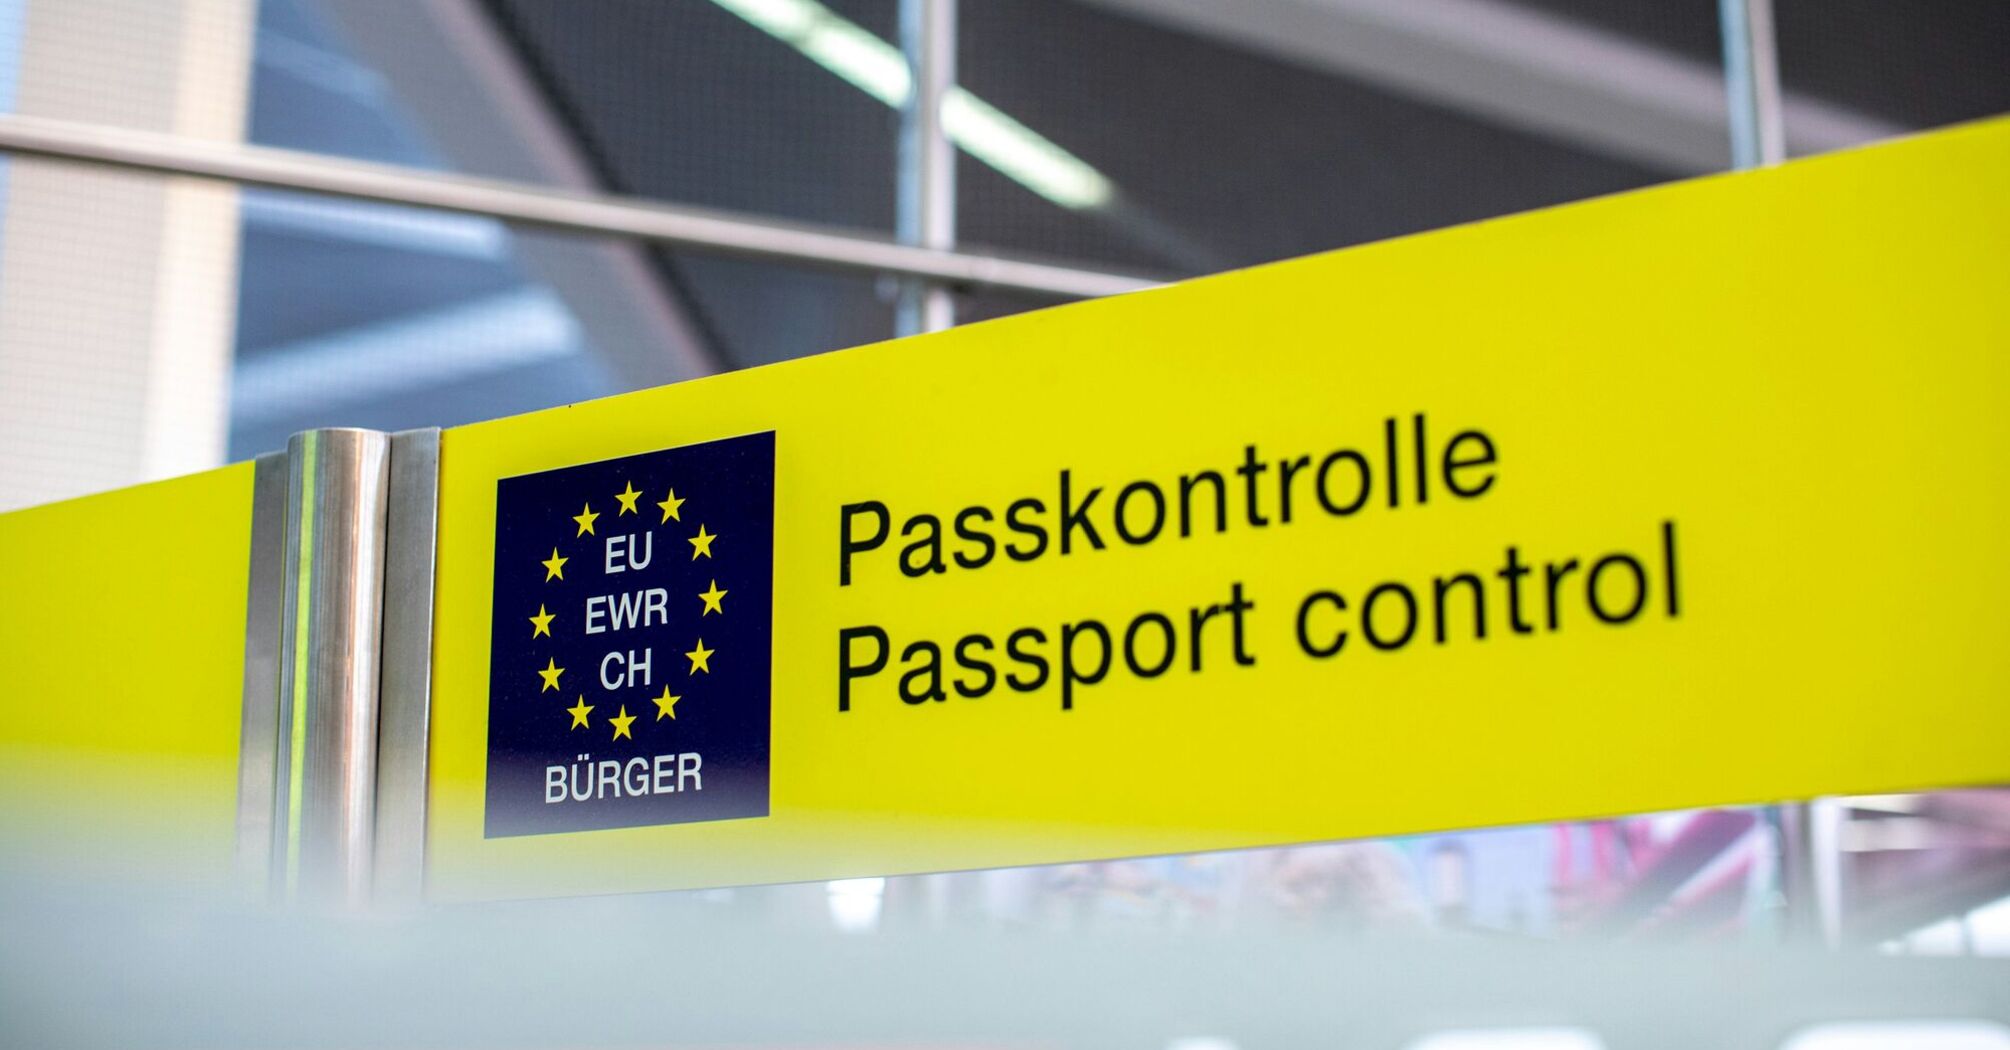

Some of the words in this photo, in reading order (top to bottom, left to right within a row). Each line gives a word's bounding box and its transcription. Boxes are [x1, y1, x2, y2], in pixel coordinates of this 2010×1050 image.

[839, 412, 1498, 587] Passkontrolle
[604, 530, 653, 574] EU
[585, 587, 668, 635] EWR
[838, 582, 1256, 713] Passport
[1295, 520, 1680, 660] control
[600, 648, 652, 691] CH
[544, 753, 703, 805] BÜRGER
